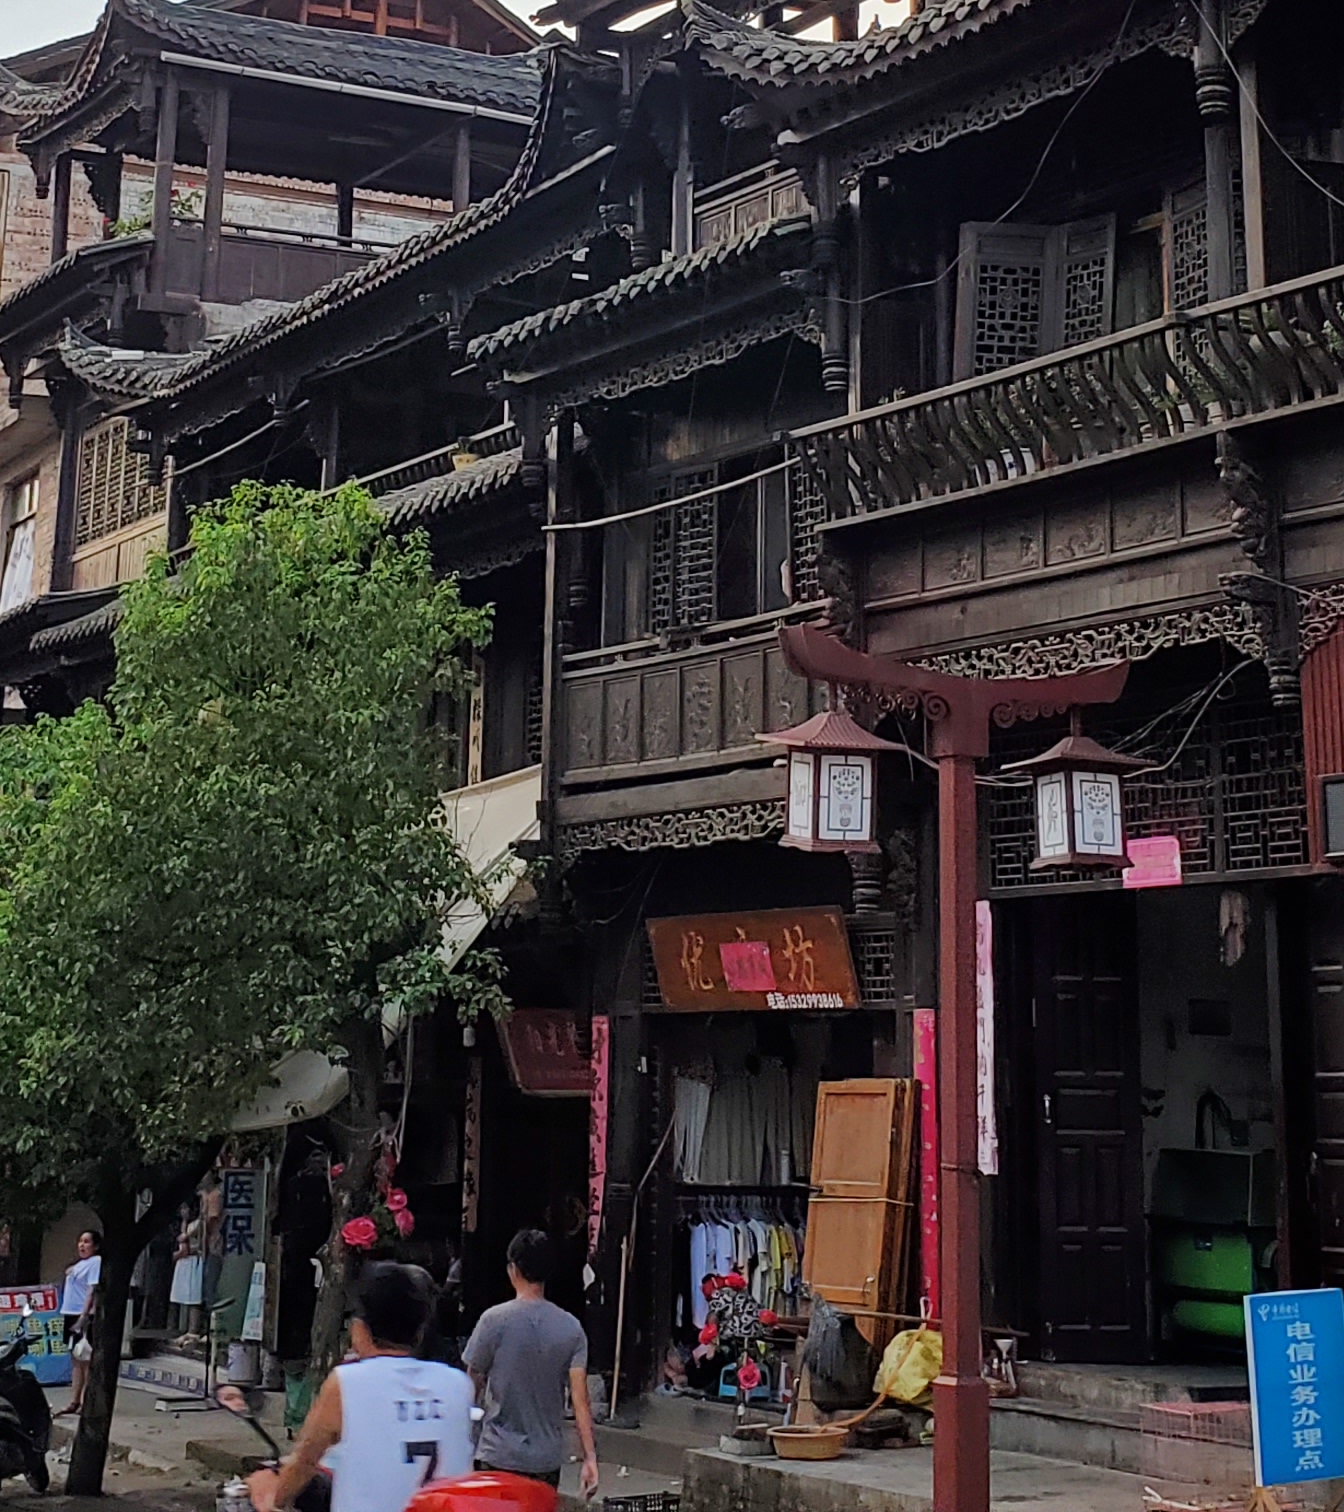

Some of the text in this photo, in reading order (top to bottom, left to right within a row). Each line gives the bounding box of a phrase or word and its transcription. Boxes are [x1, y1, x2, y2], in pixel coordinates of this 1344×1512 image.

[680, 924, 814, 991] 悦坊
[223, 1171, 255, 1256] 医保
[1285, 1320, 1324, 1472] 电信业务办理点
[405, 1441, 438, 1488] 7
